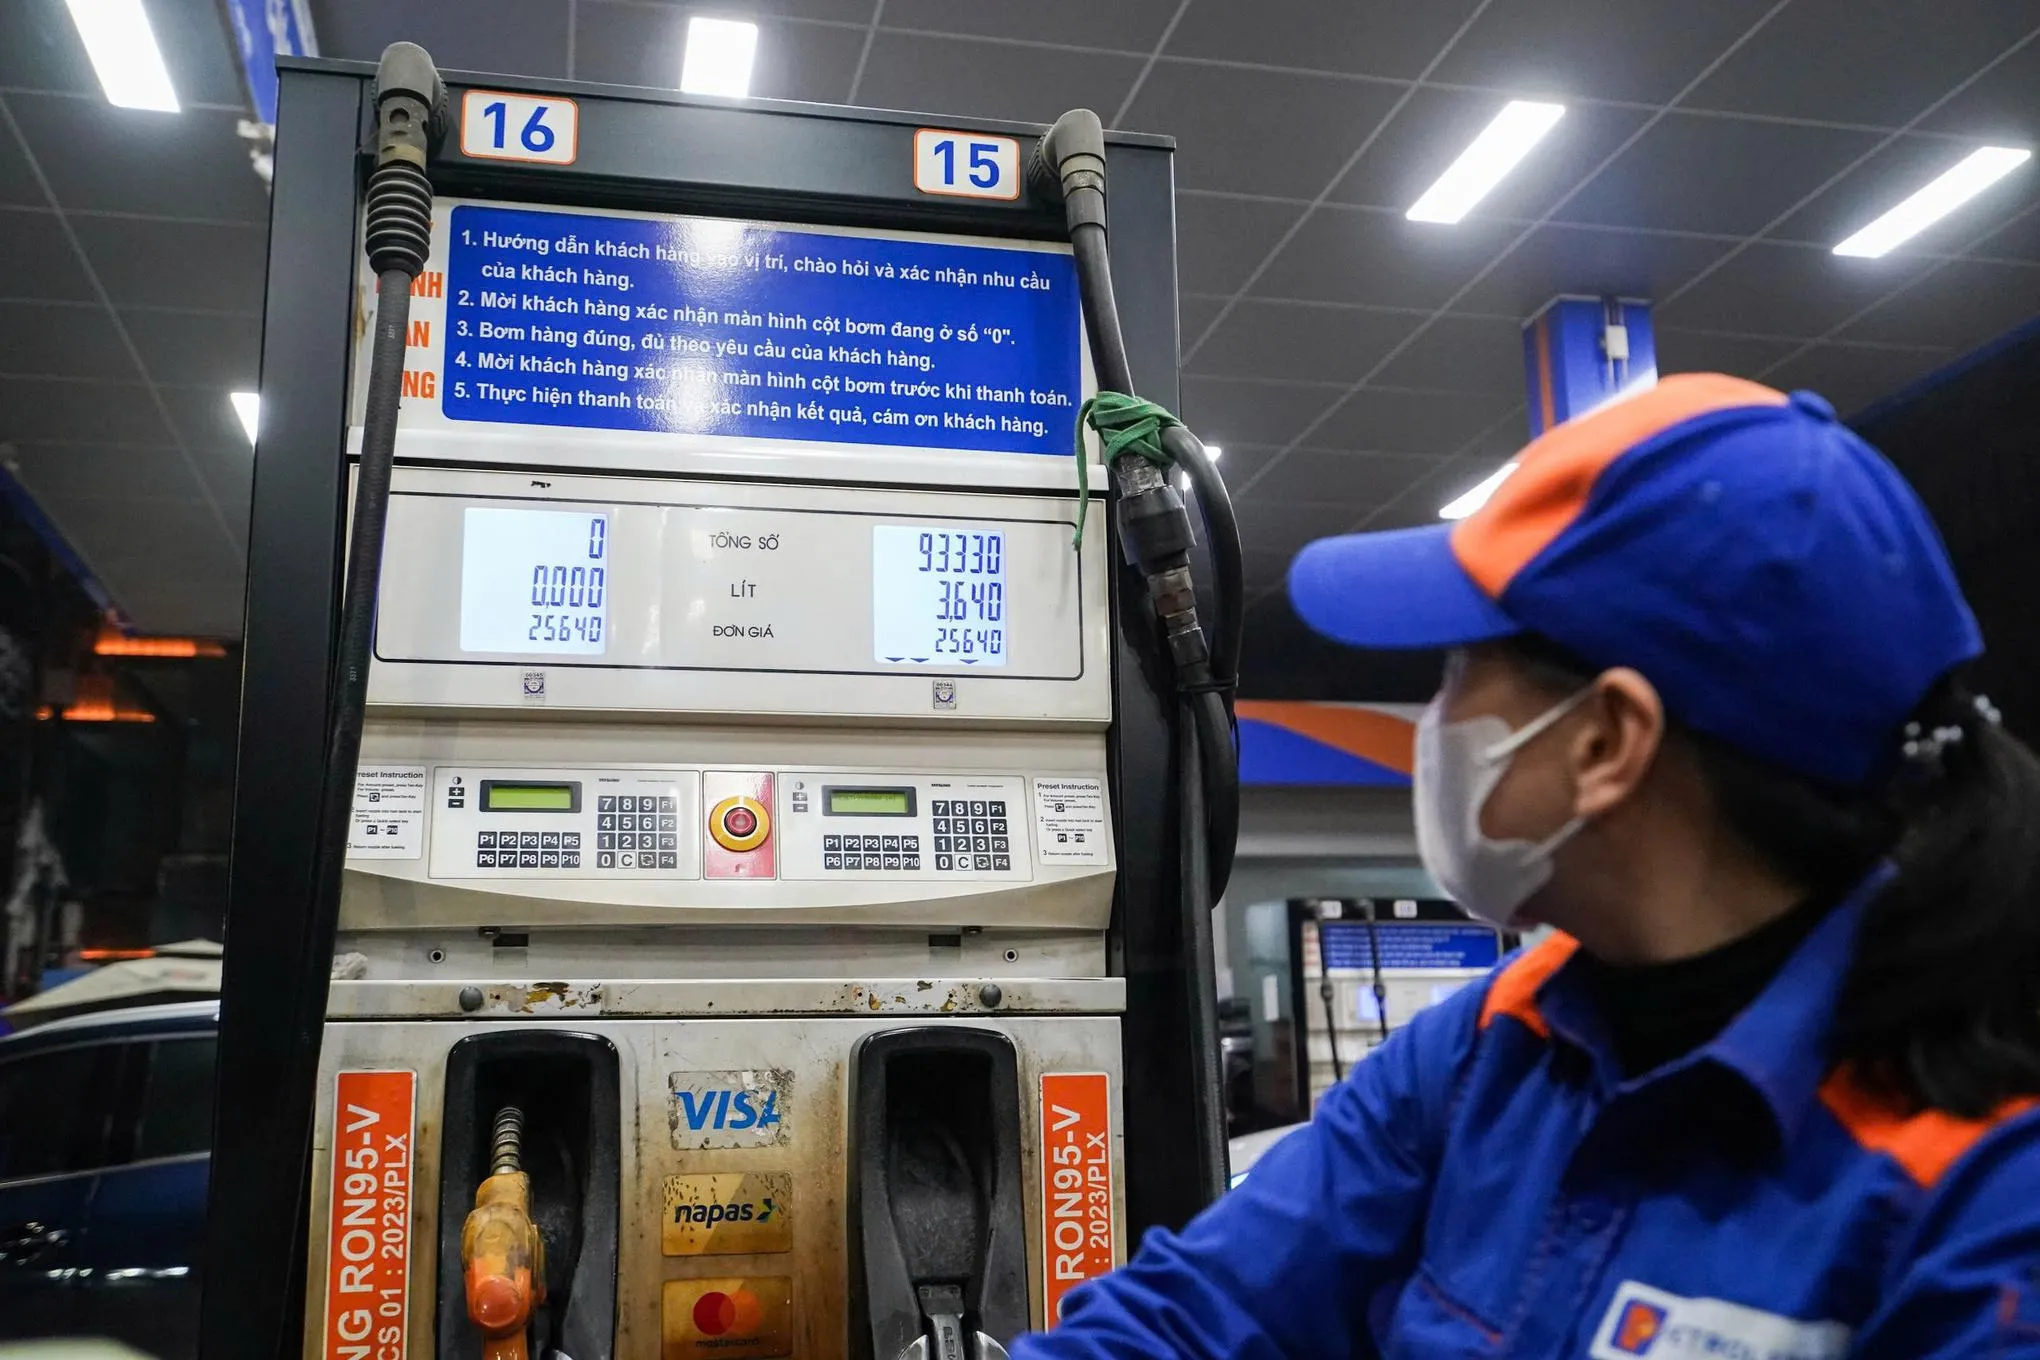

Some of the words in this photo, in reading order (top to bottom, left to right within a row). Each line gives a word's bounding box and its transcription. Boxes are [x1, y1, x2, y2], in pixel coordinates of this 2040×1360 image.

[484, 102, 555, 153] 16
[934, 140, 1000, 188] 15
[462, 230, 477, 246] 1.
[483, 231, 548, 255] Hướng
[555, 235, 588, 254] dẫn
[595, 240, 649, 259] khách
[745, 252, 759, 271] vị
[765, 254, 788, 272] trí,
[794, 256, 837, 274] chào
[842, 259, 869, 276] hỏi
[875, 262, 894, 278] và
[900, 264, 929, 281] xác
[935, 268, 977, 287] nhận
[983, 271, 1014, 288] nhu
[1020, 270, 1050, 290] cầu
[482, 262, 515, 279] của
[522, 264, 577, 284] khách
[584, 268, 634, 291] hàng.
[458, 290, 474, 306] 2.
[481, 292, 516, 309] Mời
[523, 295, 578, 314] khách
[585, 299, 630, 321] hàng
[636, 304, 667, 319] xác
[674, 304, 718, 327] nhận
[724, 310, 762, 327] màn
[769, 312, 806, 330] hình
[812, 317, 840, 335] cột
[846, 317, 885, 335] bơm
[891, 322, 934, 342] đang
[940, 325, 953, 340] ở
[957, 323, 978, 342] số
[457, 320, 473, 337] 3.
[480, 321, 525, 340] Bơm
[531, 326, 577, 347] hàng
[583, 330, 635, 351] đúng,
[641, 333, 664, 350] đủ
[670, 335, 710, 352] theo
[716, 339, 747, 357] yêu
[754, 338, 785, 358] cầu
[791, 344, 822, 361] của
[829, 347, 881, 364] khách
[888, 350, 935, 371] hàng.
[455, 351, 471, 367] 4.
[478, 352, 514, 370] Mời
[520, 355, 576, 375] khách
[582, 359, 628, 381] hàng
[634, 364, 666, 379] xác
[724, 370, 761, 386] màn
[767, 371, 806, 389] hình
[812, 376, 840, 394] cột
[845, 377, 885, 394] bơm
[891, 381, 940, 398] trước
[946, 383, 971, 399] khi
[976, 386, 1024, 403] thanh
[1030, 390, 1072, 406] toán.
[454, 382, 470, 398] 5.
[477, 383, 526, 404] Thực
[533, 386, 572, 407] hiện
[578, 390, 630, 409] thanh
[747, 401, 791, 422] nhận
[797, 401, 824, 420] kết
[829, 407, 867, 425] quả,
[873, 409, 909, 426] cám
[915, 414, 938, 427] ơn
[944, 412, 995, 431] khách
[1001, 416, 1048, 437] hàng.
[589, 518, 605, 559] 0
[709, 531, 752, 549] TỔNG
[759, 534, 780, 550] SỐ
[919, 533, 1000, 574] 93330
[731, 580, 756, 597] LÍT
[528, 614, 601, 642] 25640
[713, 624, 744, 637] ĐƠN
[748, 624, 774, 638] GIÁ
[935, 628, 1001, 654] 25640
[602, 798, 612, 810] 7
[623, 799, 632, 810] 8
[643, 799, 652, 810] 9
[936, 803, 945, 814] 7
[955, 803, 964, 814] 8
[974, 803, 983, 814] 9
[602, 817, 611, 828] 4
[623, 817, 631, 829] 5
[643, 817, 652, 829] 6
[938, 821, 946, 832] 4
[957, 821, 965, 832] 5
[976, 821, 984, 832] 6
[993, 823, 1005, 831] F2
[480, 835, 494, 845] P1
[501, 836, 516, 845] P2
[522, 836, 537, 845] P3
[543, 836, 558, 845] P4
[564, 836, 579, 845] P5
[603, 835, 609, 847] 1
[622, 836, 631, 847] 2
[643, 836, 652, 847] 3
[826, 839, 838, 848] P1
[845, 839, 859, 848] P2
[864, 839, 879, 848] P3
[884, 839, 898, 848] P4
[904, 840, 917, 848] P5
[939, 838, 945, 850] 1
[958, 839, 966, 850] 2
[977, 839, 985, 850] 3
[480, 854, 494, 864] P6
[500, 855, 516, 864] P7
[521, 855, 536, 864] P8
[542, 855, 557, 864] P9
[562, 856, 579, 864] P10
[601, 854, 611, 866] 0
[621, 854, 632, 866] C
[662, 856, 674, 864] F4
[826, 857, 840, 866] P6
[846, 857, 860, 866] P7
[866, 857, 879, 866] P8
[885, 857, 899, 866] P9
[904, 858, 919, 866] P10
[940, 857, 948, 868] 0
[959, 857, 968, 868] C
[673, 1090, 781, 1130] VISA
[339, 1104, 380, 1293] RON95-V
[382, 1133, 407, 1259] 2023/PLX
[1052, 1104, 1084, 1280] RON95-V
[1087, 1131, 1109, 1248] 2023/PLX
[674, 1203, 753, 1229] napas
[379, 1288, 402, 1317] 01
